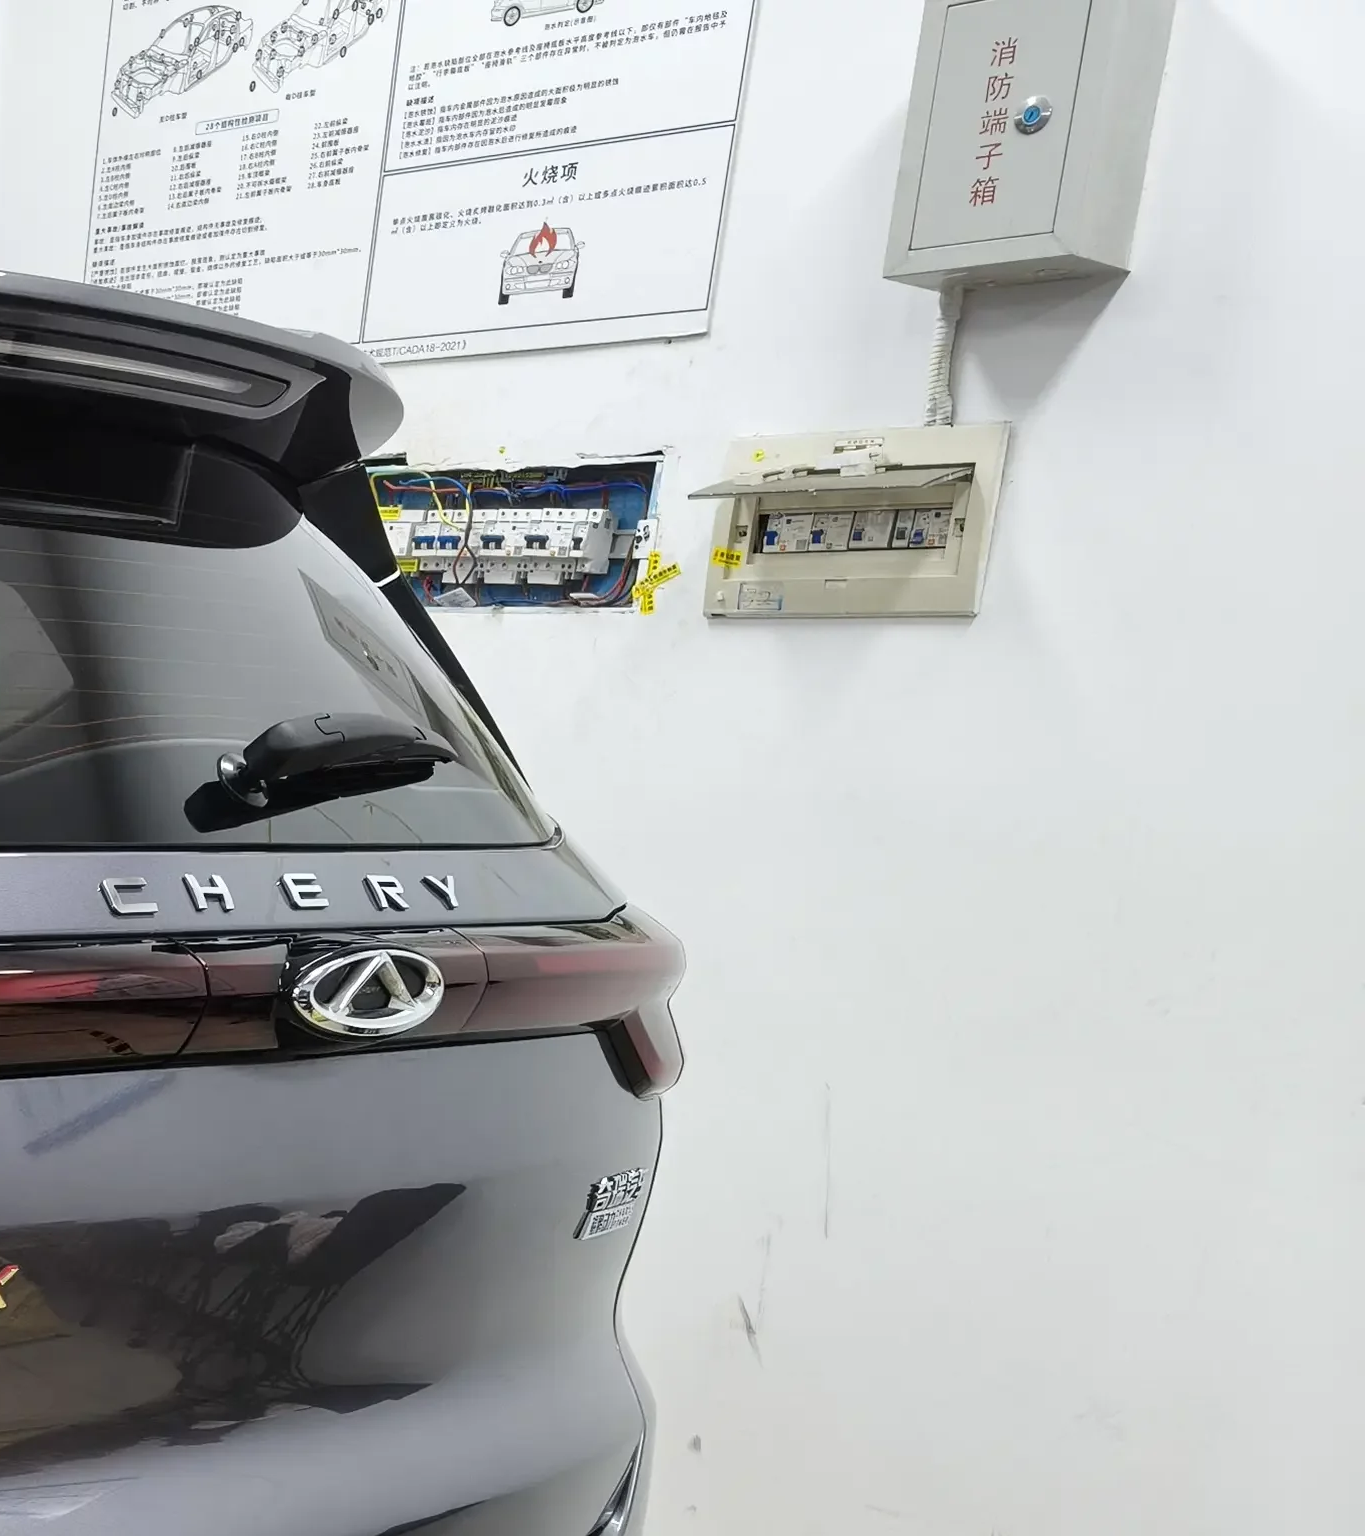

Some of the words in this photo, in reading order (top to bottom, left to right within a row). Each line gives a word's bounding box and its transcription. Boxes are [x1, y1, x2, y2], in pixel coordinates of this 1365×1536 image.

[969, 36, 1018, 207] 消防端子箱
[522, 161, 579, 188] 火烧项
[98, 872, 459, 917] CHERY
[589, 1166, 649, 1213] 奇瑞汽
